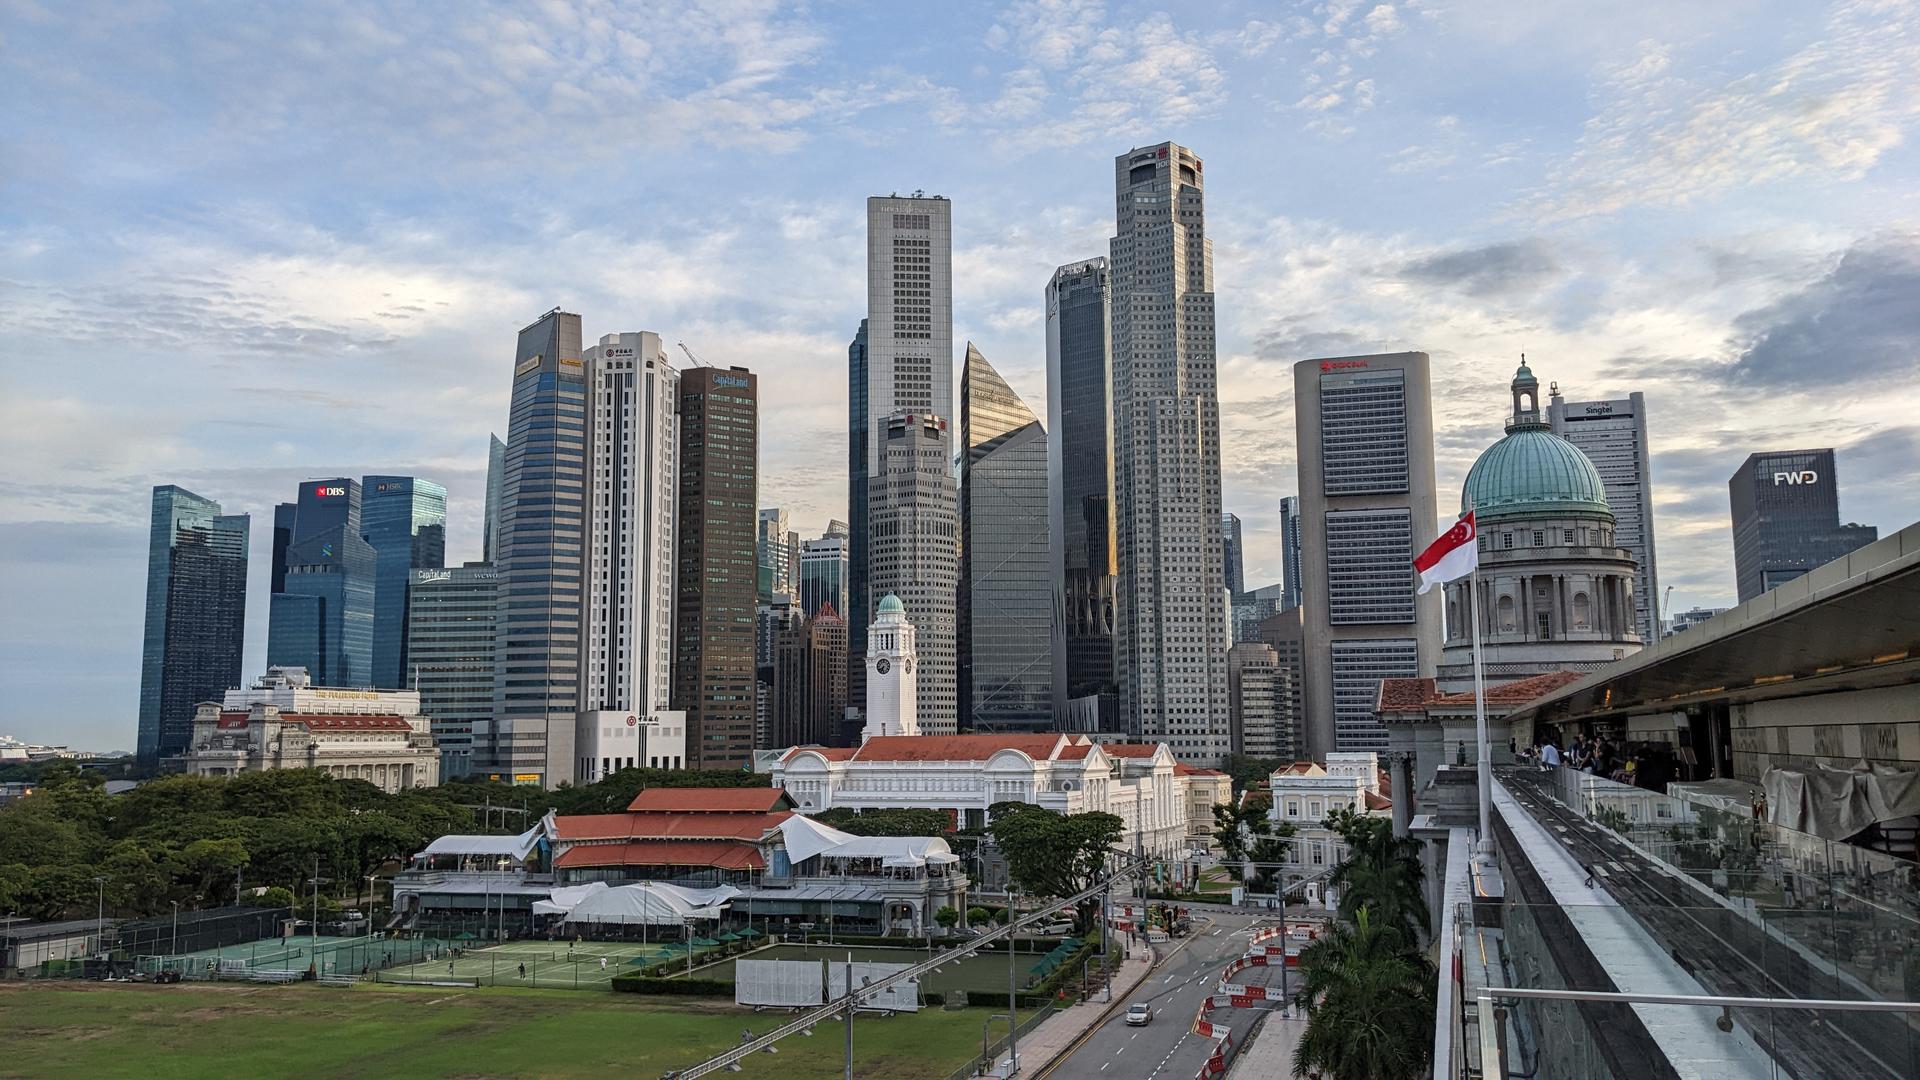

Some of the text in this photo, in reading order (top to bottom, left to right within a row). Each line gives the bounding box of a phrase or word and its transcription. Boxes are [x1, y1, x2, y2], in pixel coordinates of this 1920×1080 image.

[1585, 406, 1613, 415] Singtel
[1774, 471, 1817, 486] FWD
[326, 487, 345, 496] DBS
[418, 568, 452, 579] CapitaLand
